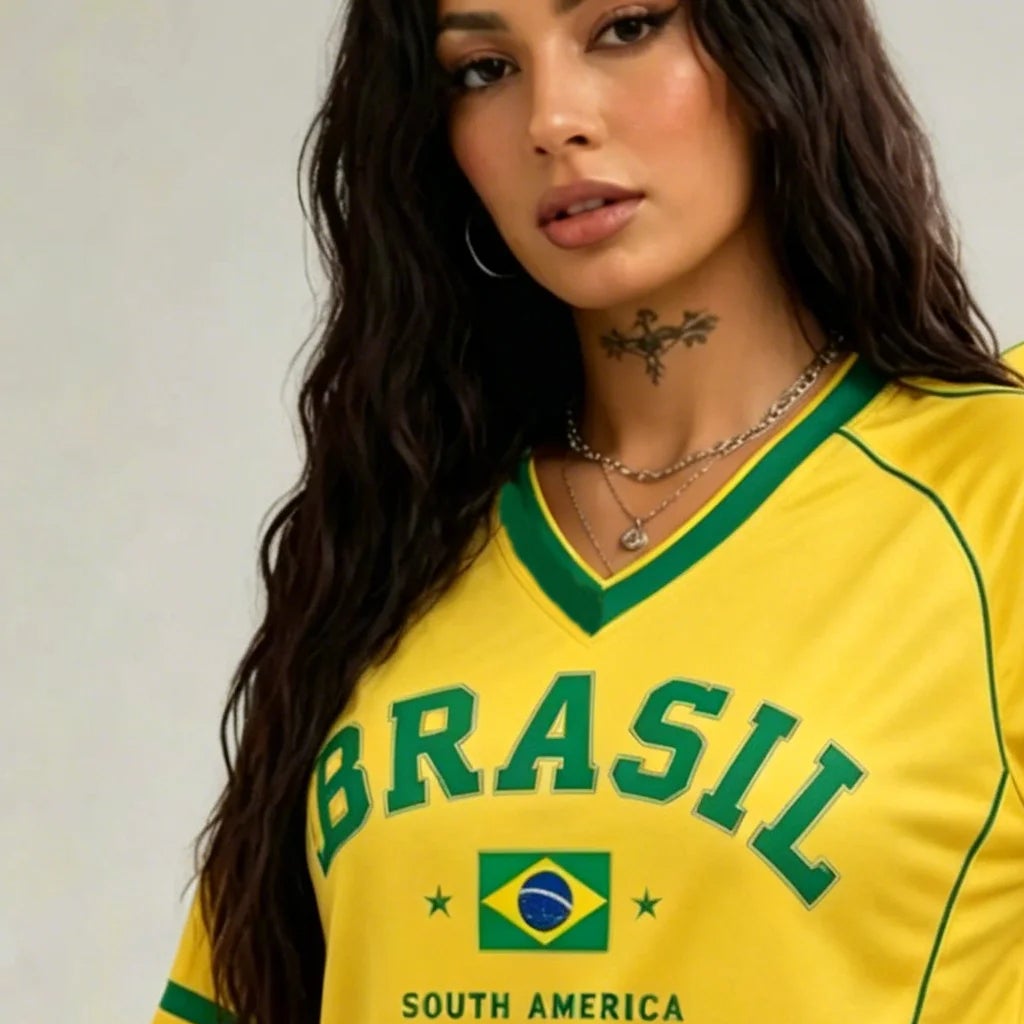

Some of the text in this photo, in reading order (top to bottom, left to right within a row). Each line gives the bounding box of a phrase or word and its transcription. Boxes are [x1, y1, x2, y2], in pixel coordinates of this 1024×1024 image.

[309, 671, 868, 911] BRASIL
[401, 992, 684, 1022] SOUTH AMERICA
